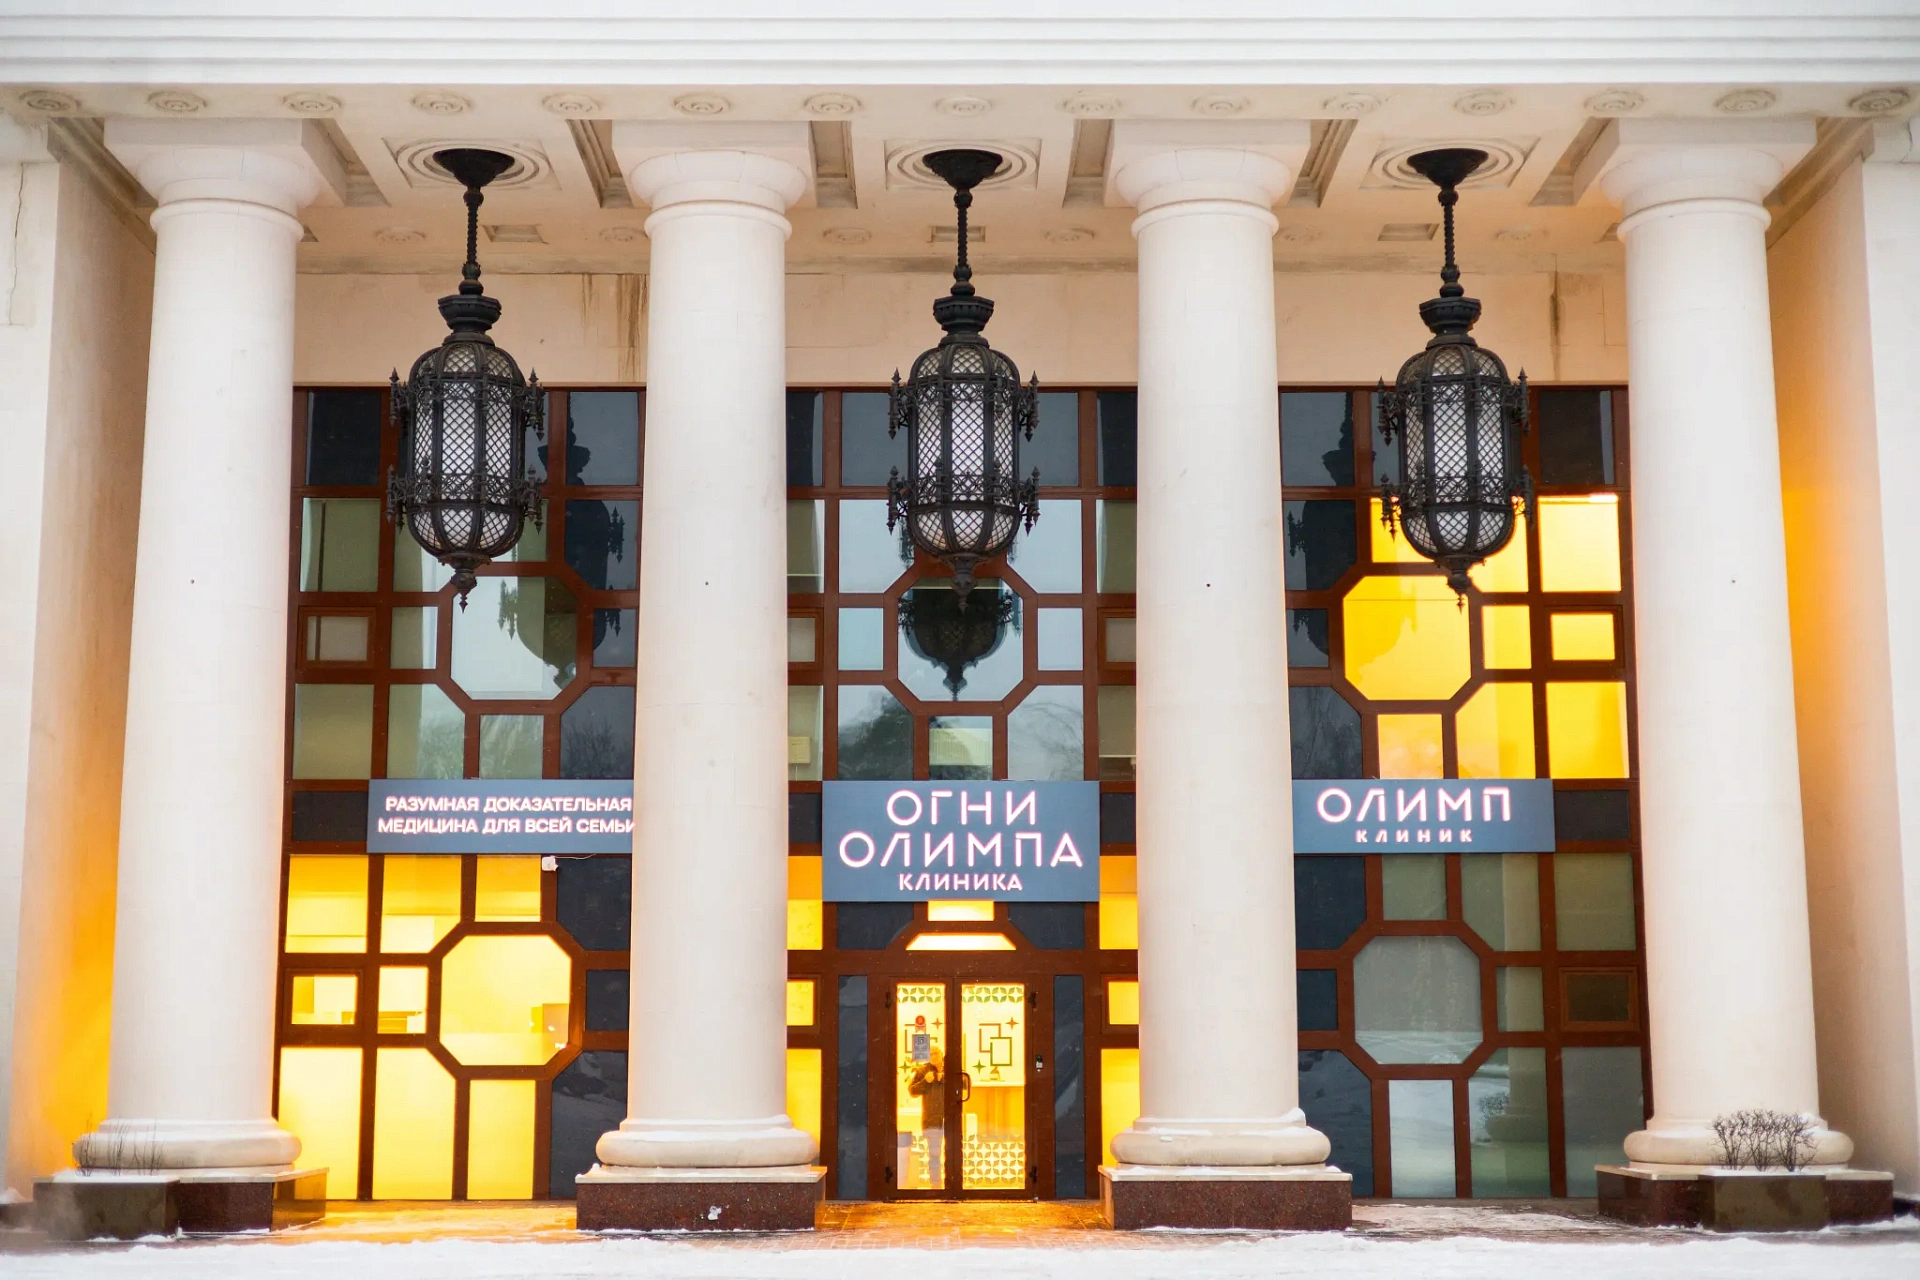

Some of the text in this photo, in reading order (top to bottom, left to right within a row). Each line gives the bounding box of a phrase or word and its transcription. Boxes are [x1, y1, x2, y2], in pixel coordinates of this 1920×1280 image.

[385, 796, 632, 813] РАЗУМНАЯ ДОКАЗАТЕЛЬНАЯ
[887, 789, 1036, 826] ОГНИ
[1317, 787, 1511, 823] ОЛИМП
[378, 817, 478, 835] МЕДИЦИНА
[482, 817, 520, 835] ДЛЯ
[525, 816, 572, 833] ВСЕЙ
[1355, 829, 1473, 843] КЛИНИК
[839, 831, 1083, 868] ОЛИМПА
[899, 873, 1023, 891] КЛИНИКА
